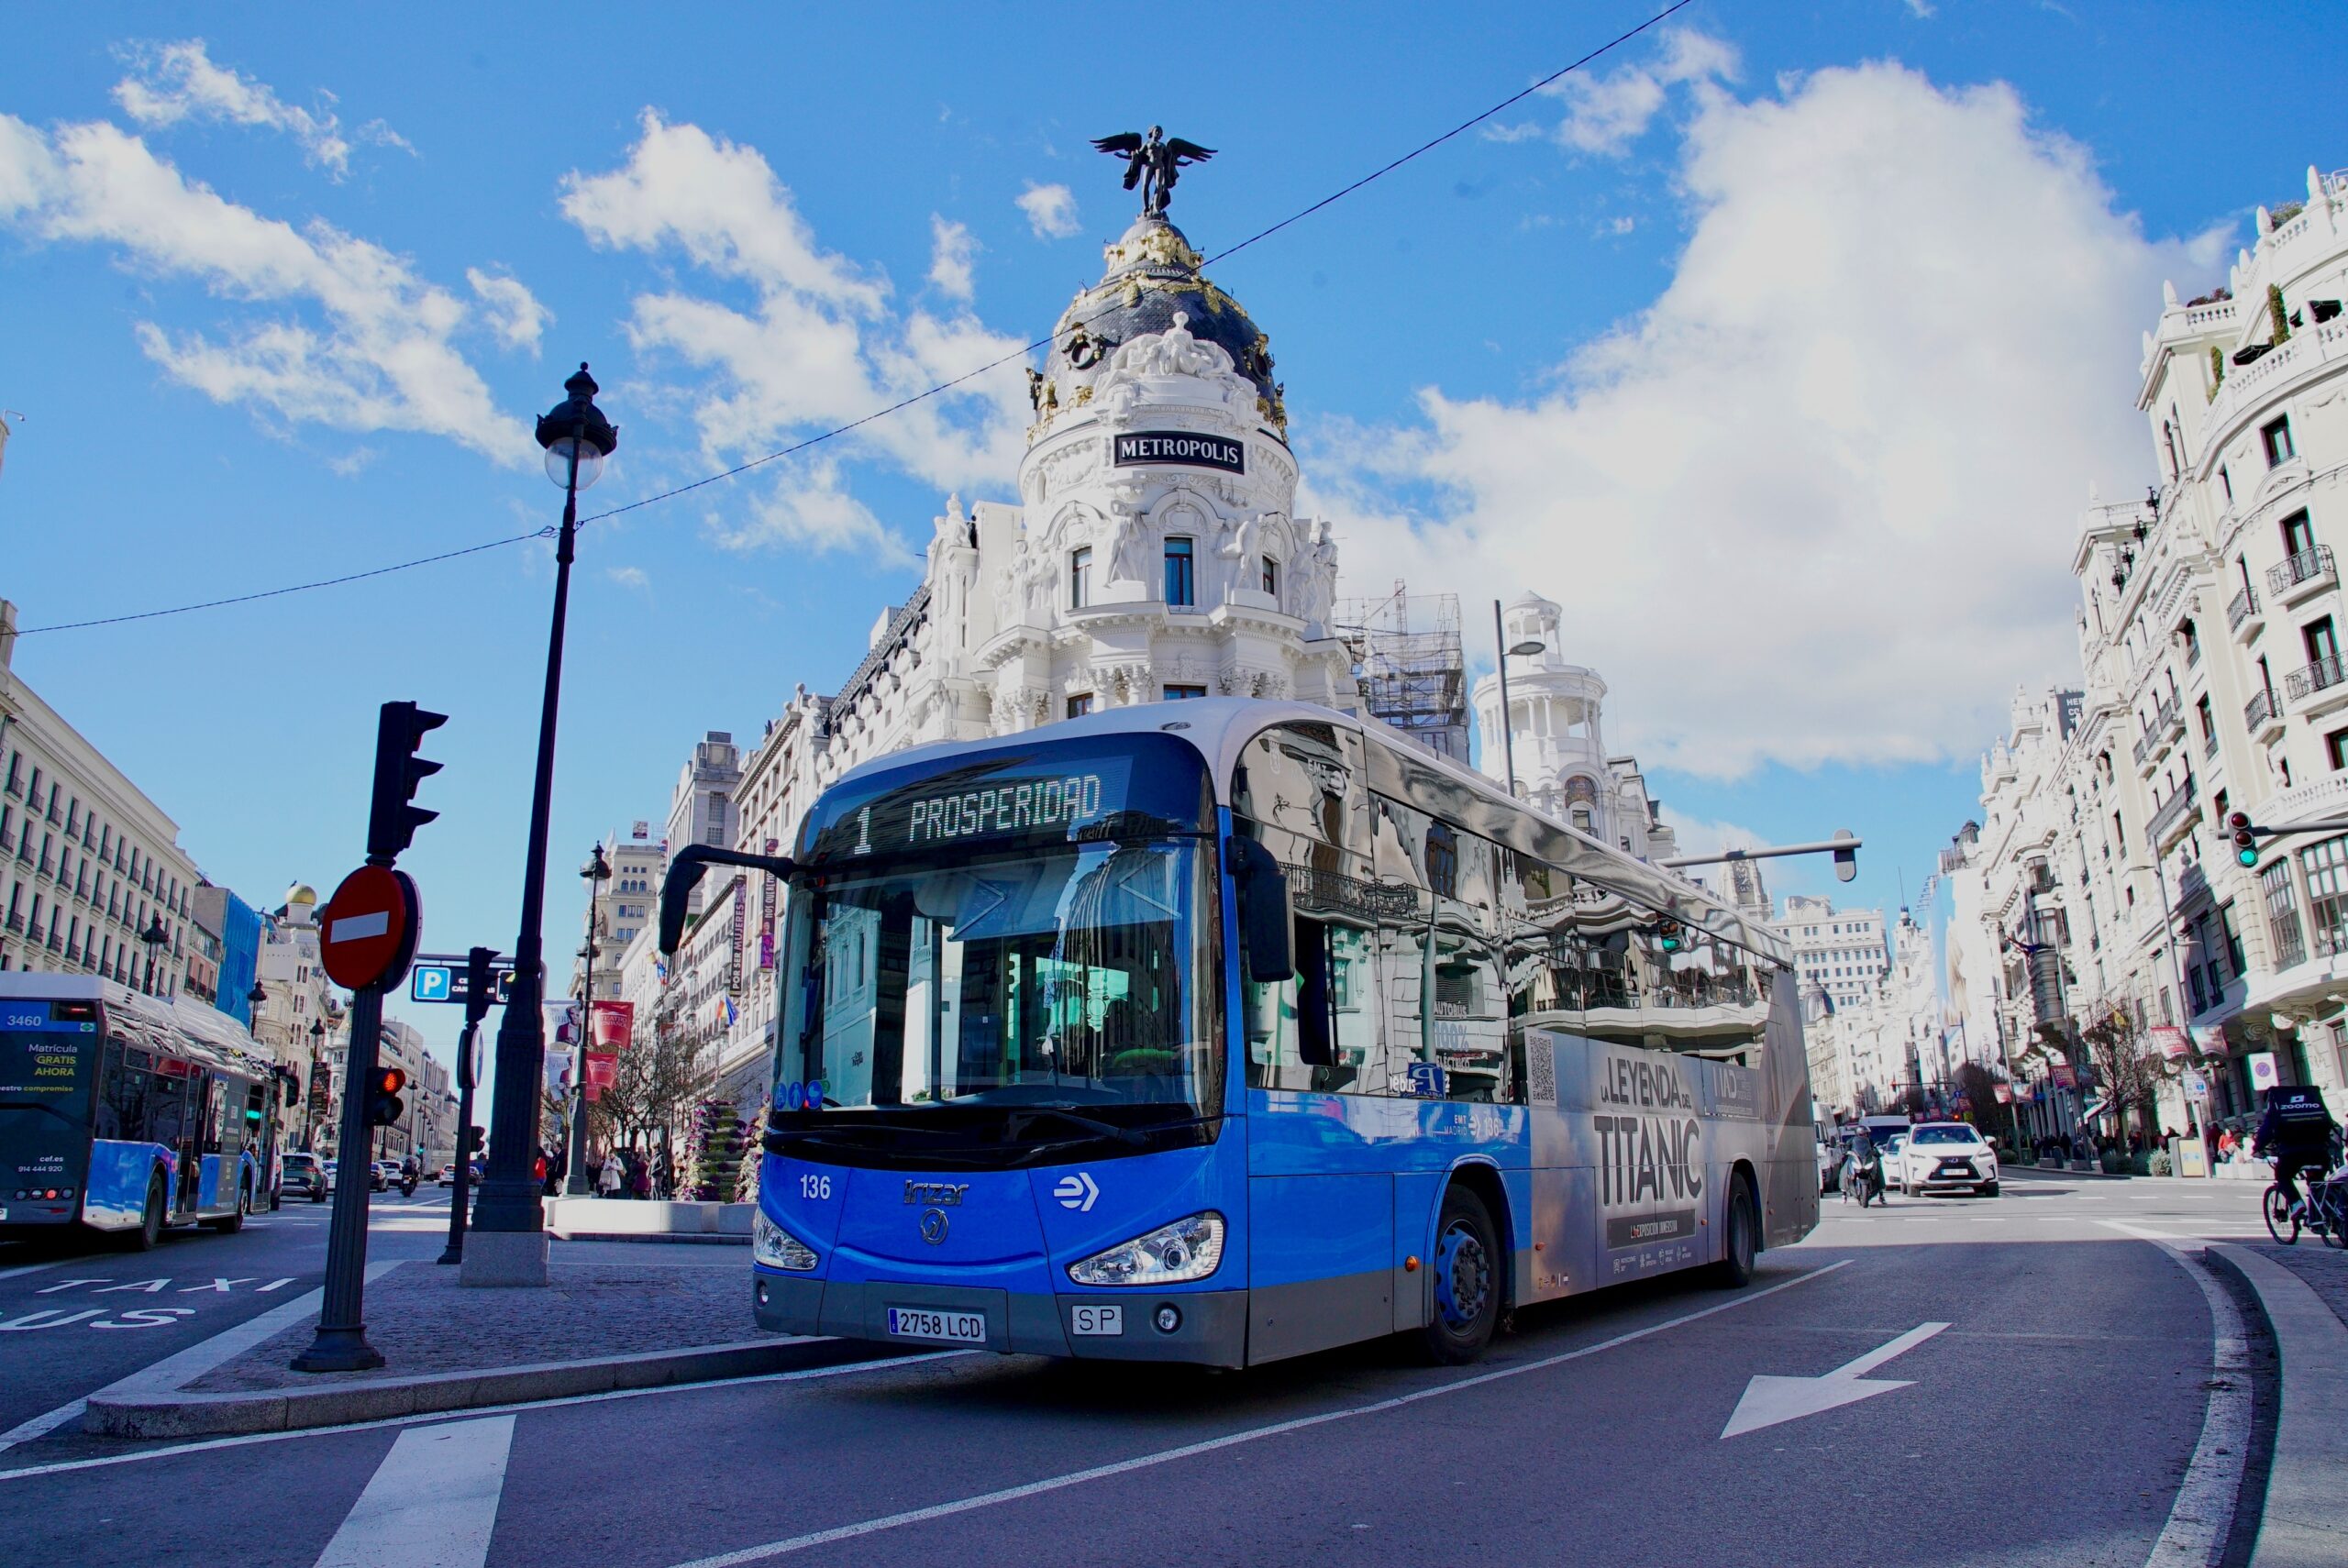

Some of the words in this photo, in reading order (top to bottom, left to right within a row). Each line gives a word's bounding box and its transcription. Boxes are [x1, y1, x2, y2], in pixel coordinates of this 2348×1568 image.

[1122, 438, 1238, 464] METROPOLIS
[854, 806, 871, 855] 1
[909, 775, 1101, 842] PROSPERIDAD
[765, 869, 776, 904] QUEREMO
[734, 903, 744, 951] MUJERES
[734, 952, 742, 968] SER
[423, 972, 442, 995] P
[733, 970, 741, 989] POR
[1434, 1000, 1467, 1019] AUTOBÚS
[7, 1015, 41, 1027] 3460
[1434, 1021, 1469, 1052] 100%
[28, 1044, 78, 1054] Matrícula
[37, 1055, 76, 1065] GRATIS
[1435, 1053, 1470, 1071] ELÉCTRICO
[35, 1068, 74, 1077] AHORA
[1600, 1085, 1609, 1103] LA
[1608, 1057, 1682, 1110] LEYENDA
[1681, 1093, 1692, 1110] DEL
[1455, 1115, 1467, 1124] EMT
[1484, 1117, 1500, 1137] 136
[1444, 1125, 1468, 1136] MADRID
[1594, 1115, 1702, 1207] TITANIC
[800, 1174, 831, 1199] 136
[35, 1277, 299, 1293] TAXI
[0, 1309, 196, 1330] US
[900, 1312, 942, 1335] 2758
[947, 1316, 980, 1338] LCD
[1079, 1309, 1115, 1331] SP
